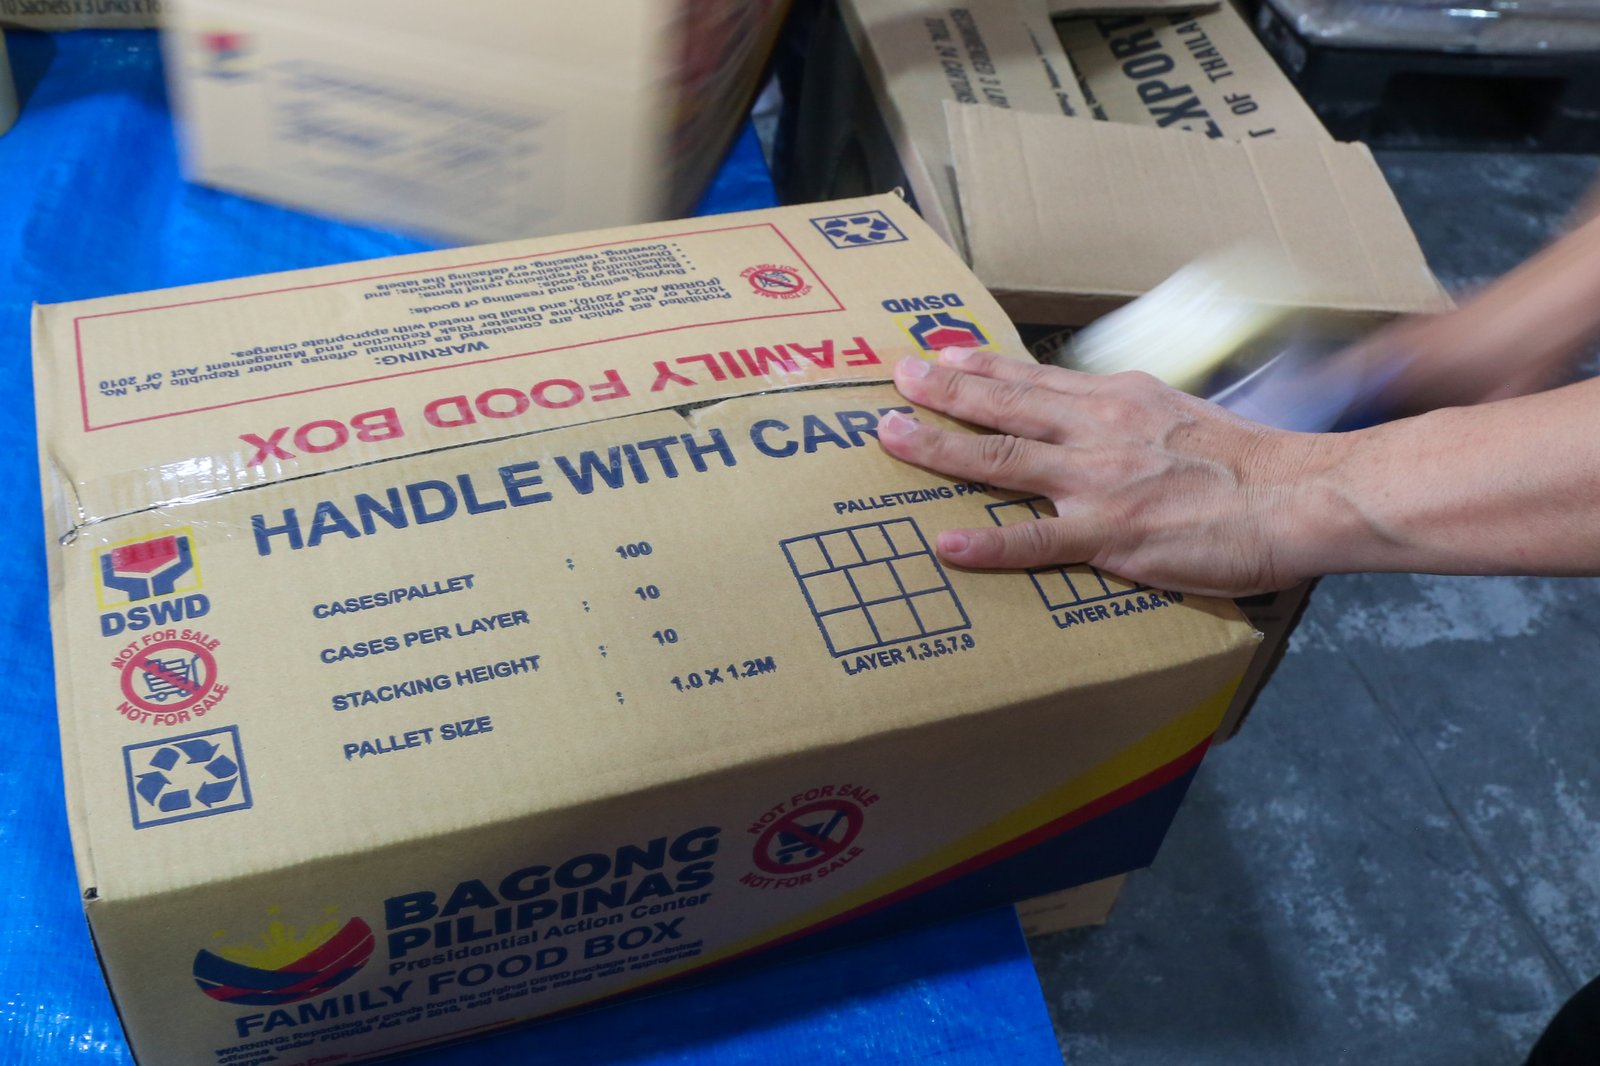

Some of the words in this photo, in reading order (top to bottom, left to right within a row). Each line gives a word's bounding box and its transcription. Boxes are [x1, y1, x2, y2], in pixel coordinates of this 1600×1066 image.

[1223, 92, 1259, 116] OF
[577, 275, 630, 288] selling,
[630, 268, 687, 279] Buying,
[547, 285, 575, 295] and
[633, 286, 658, 296] Act
[660, 277, 721, 292] (PDRRM
[685, 285, 725, 296] 10121
[481, 290, 545, 304] reselling
[568, 293, 614, 308] 2010),
[616, 290, 632, 299] of
[631, 294, 656, 307] the
[658, 291, 732, 307] Prohibited
[663, 290, 680, 301] or
[408, 301, 461, 314] goods;
[464, 299, 479, 308] of
[538, 301, 566, 312] and
[550, 299, 625, 317] Philippine
[628, 302, 653, 312] act
[881, 293, 964, 313] DSWD
[477, 312, 498, 320] be
[499, 306, 536, 318] shall
[548, 315, 572, 325] are
[578, 307, 624, 320] which
[392, 323, 426, 334] with
[427, 316, 475, 329] meted
[481, 313, 544, 328] Disaster
[301, 328, 389, 347] appropriate
[438, 324, 474, 335] Risk
[459, 321, 542, 341] considered
[352, 330, 432, 348] Reduction
[365, 339, 427, 355] criminal
[433, 335, 452, 343] as
[230, 342, 298, 358] charges.
[300, 349, 358, 364] offense
[314, 344, 344, 355] and
[374, 340, 489, 366] WARNING:
[205, 350, 307, 372] Management
[247, 360, 293, 374] under
[652, 337, 882, 392] FAMILY
[145, 371, 163, 383] of
[170, 367, 198, 378] Act
[170, 369, 240, 386] Republic
[98, 375, 137, 390] 2010
[134, 381, 162, 393] Act
[100, 387, 127, 396] No.
[424, 369, 631, 429] FOOD
[239, 407, 405, 468] BOX
[251, 461, 553, 556] HANDLE
[554, 428, 737, 495] WITH
[834, 485, 954, 514] PALLETIZING
[313, 574, 475, 619] CASES/PALLET
[615, 541, 653, 559] 100
[100, 594, 211, 637] DSWD
[1052, 604, 1109, 630] LAYER
[320, 636, 400, 664] CASES
[403, 625, 452, 649] PER
[455, 609, 530, 637] LAYER
[634, 584, 661, 601] 10
[110, 641, 140, 670] NOT
[142, 629, 177, 646] FOR
[181, 628, 221, 651] SALE
[842, 648, 905, 676] LAYER
[905, 634, 976, 662] 1,3,5,7,9
[331, 674, 453, 712] STACKING
[456, 654, 541, 689] HEIGHT
[652, 628, 679, 646] 10
[116, 701, 152, 724] NOT
[153, 710, 191, 726] FOR
[192, 683, 229, 717] SALE
[343, 728, 433, 761] PALLET
[439, 715, 494, 741] SIZE
[670, 672, 703, 692] 1.0
[705, 667, 724, 685] X
[727, 655, 777, 681] 1.2M
[747, 802, 786, 834] NOT
[791, 785, 835, 806] FOR
[837, 784, 880, 807] SALE
[739, 872, 774, 889] NOT
[774, 873, 813, 889] FOR
[817, 846, 864, 878] SALE
[384, 826, 722, 930] BAGONG
[387, 861, 715, 960] PILIPINAS
[389, 931, 538, 976] Presidential
[543, 905, 624, 940] Action
[631, 893, 712, 919] Center
[235, 980, 413, 1038] FAMILY
[429, 948, 567, 995] FOOD
[584, 917, 686, 959] BOX
[215, 1035, 291, 1058] WARNING:
